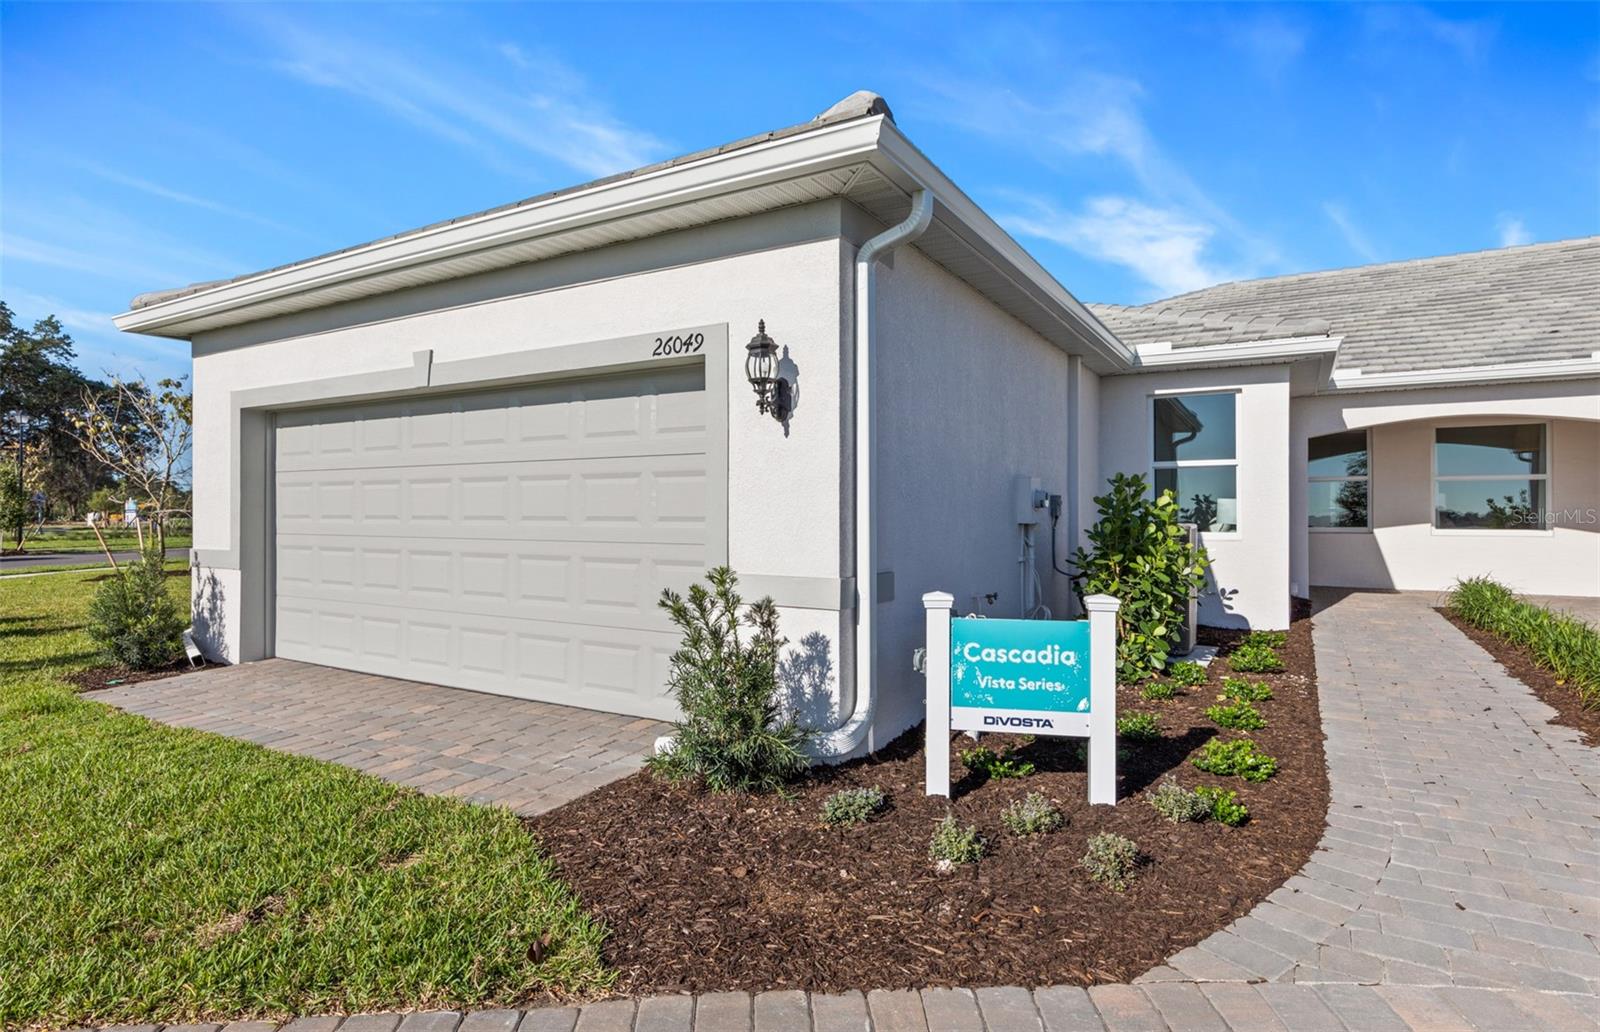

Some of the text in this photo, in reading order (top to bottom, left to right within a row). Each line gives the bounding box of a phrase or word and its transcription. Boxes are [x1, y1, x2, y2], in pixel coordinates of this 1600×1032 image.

[652, 333, 705, 357] 26049
[963, 642, 1076, 666] Cascadia
[977, 675, 1062, 692] Vista Series
